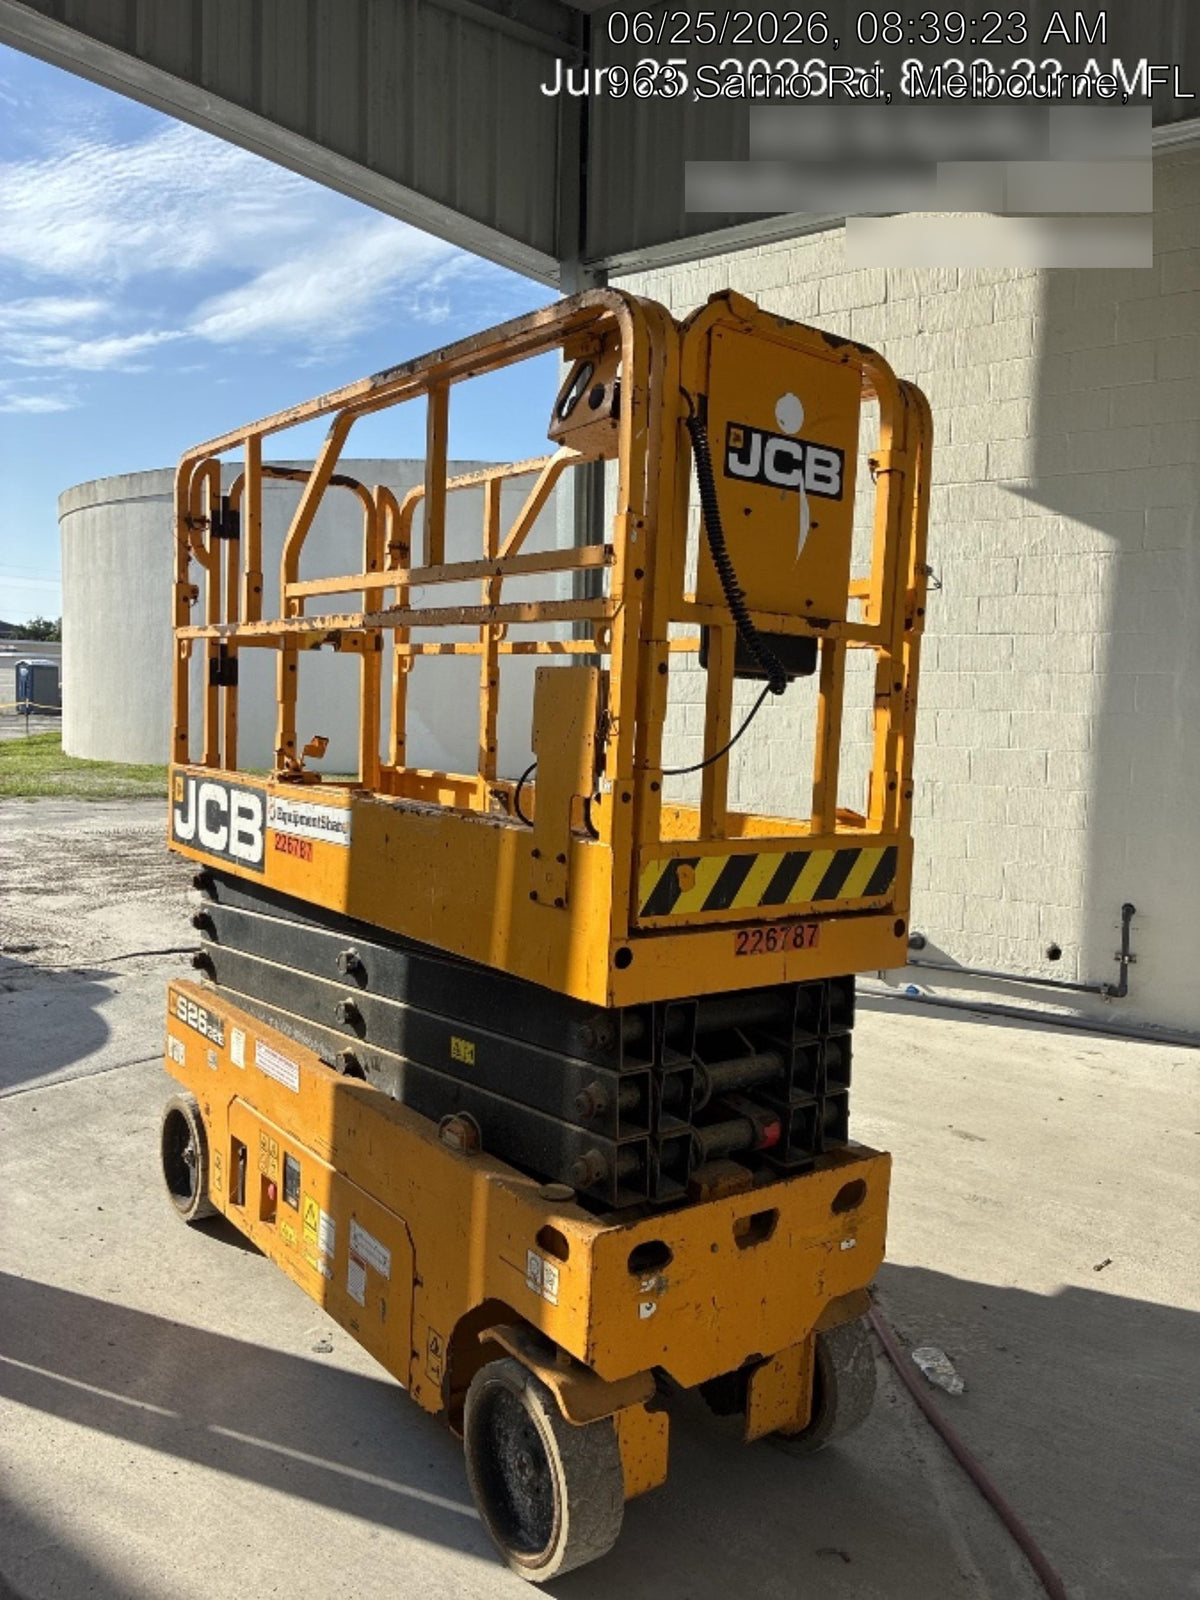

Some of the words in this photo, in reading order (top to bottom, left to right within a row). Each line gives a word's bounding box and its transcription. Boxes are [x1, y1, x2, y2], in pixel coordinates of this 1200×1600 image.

[728, 433, 842, 495] JCB
[174, 779, 264, 863] JCB
[736, 923, 818, 955] 226787
[176, 994, 207, 1035] S26
